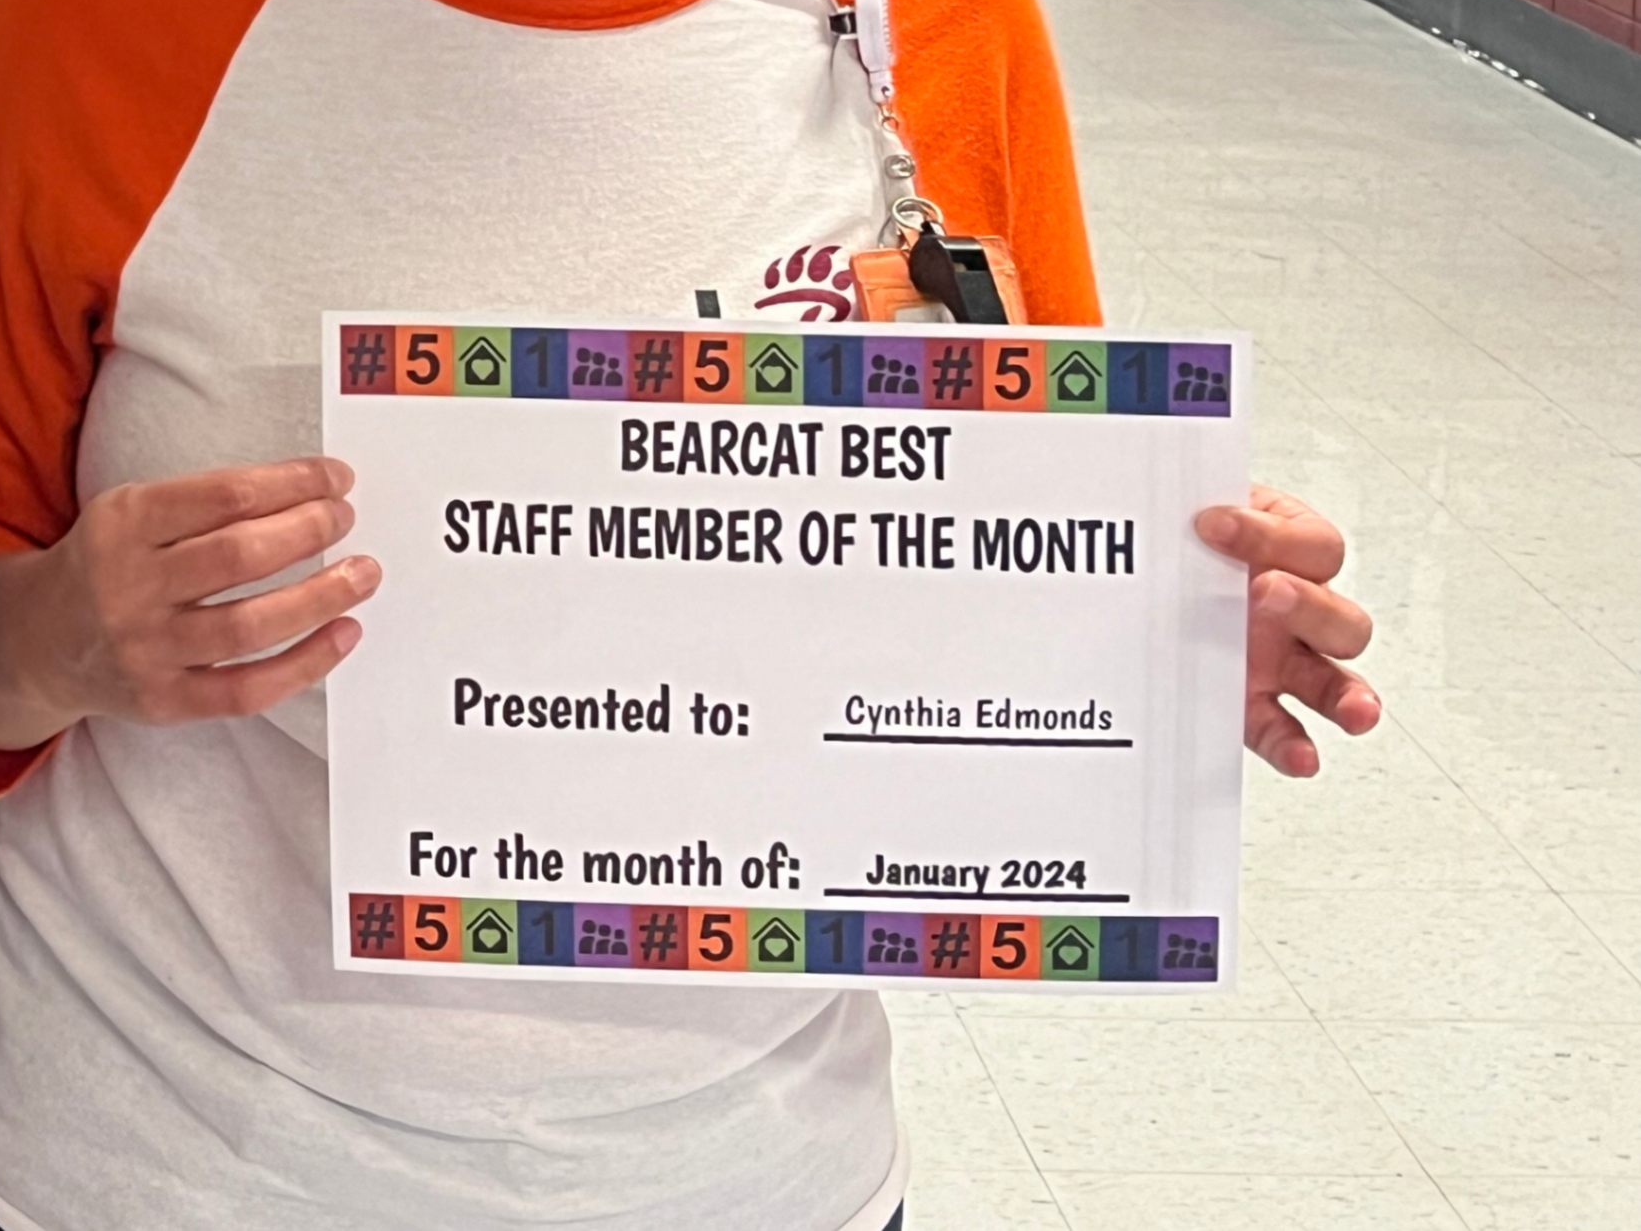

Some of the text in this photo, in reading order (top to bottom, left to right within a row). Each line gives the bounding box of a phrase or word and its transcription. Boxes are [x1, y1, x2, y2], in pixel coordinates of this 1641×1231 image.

[622, 419, 951, 480] BEARCAT BEST
[445, 500, 1133, 574] STAFF MEMBER OF THE MONTH
[455, 679, 1112, 735] Presented to: Cynthia Edmonds
[411, 832, 1085, 892] For the month of: January 2024
